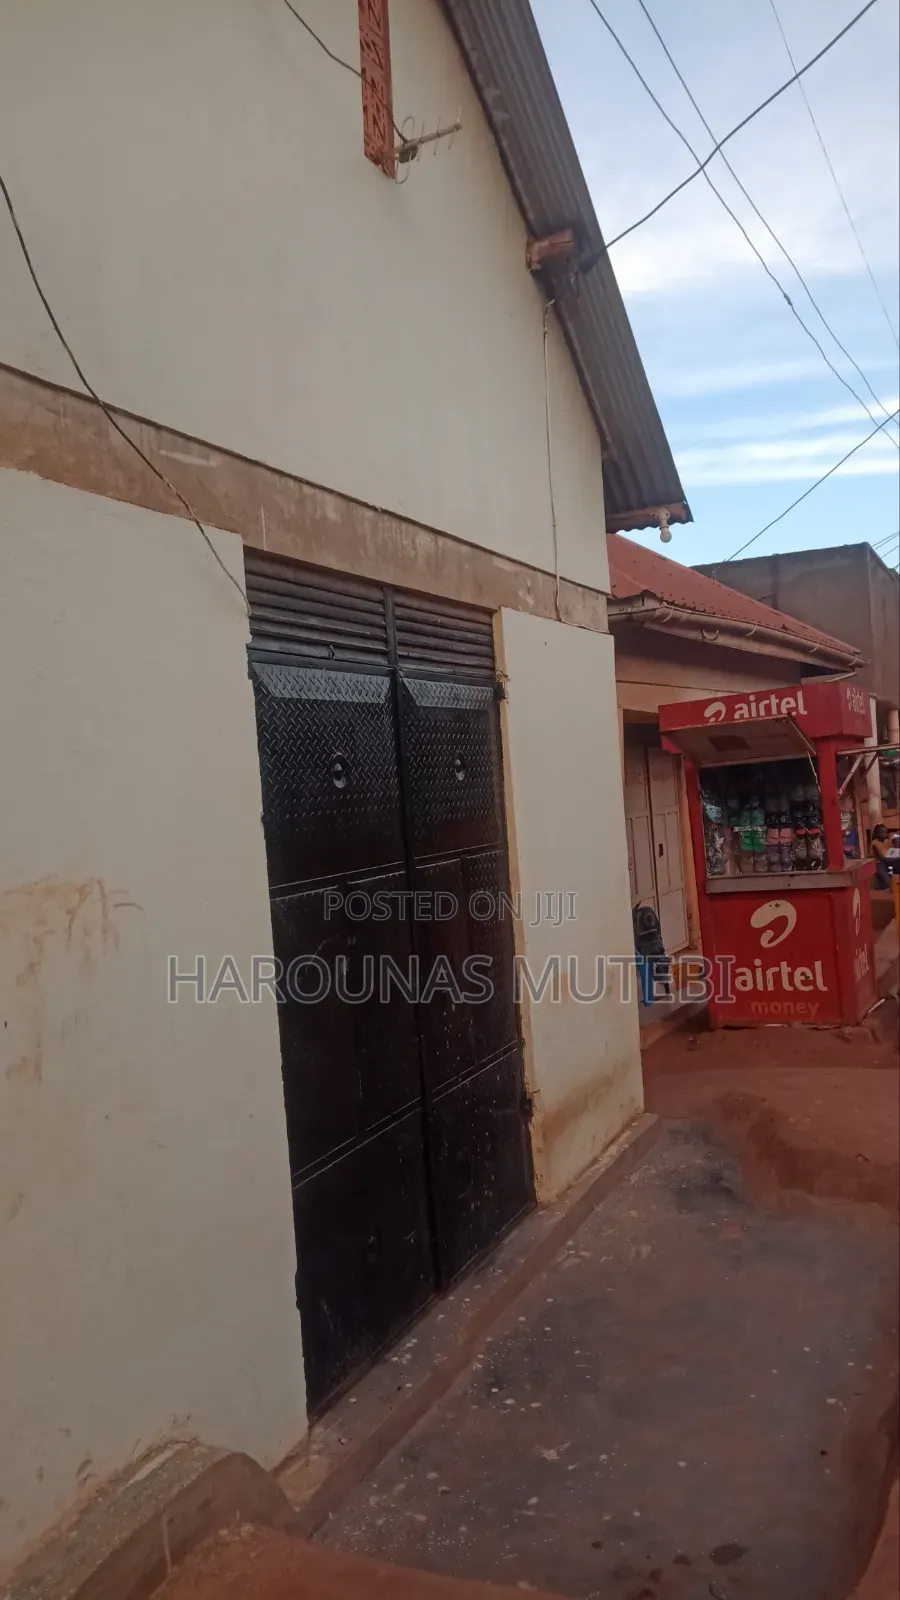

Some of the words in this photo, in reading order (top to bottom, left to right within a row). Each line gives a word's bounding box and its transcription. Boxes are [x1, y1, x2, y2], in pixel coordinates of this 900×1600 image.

[734, 691, 807, 719] airtel
[734, 958, 828, 991] airtel
[752, 1001, 819, 1018] money
